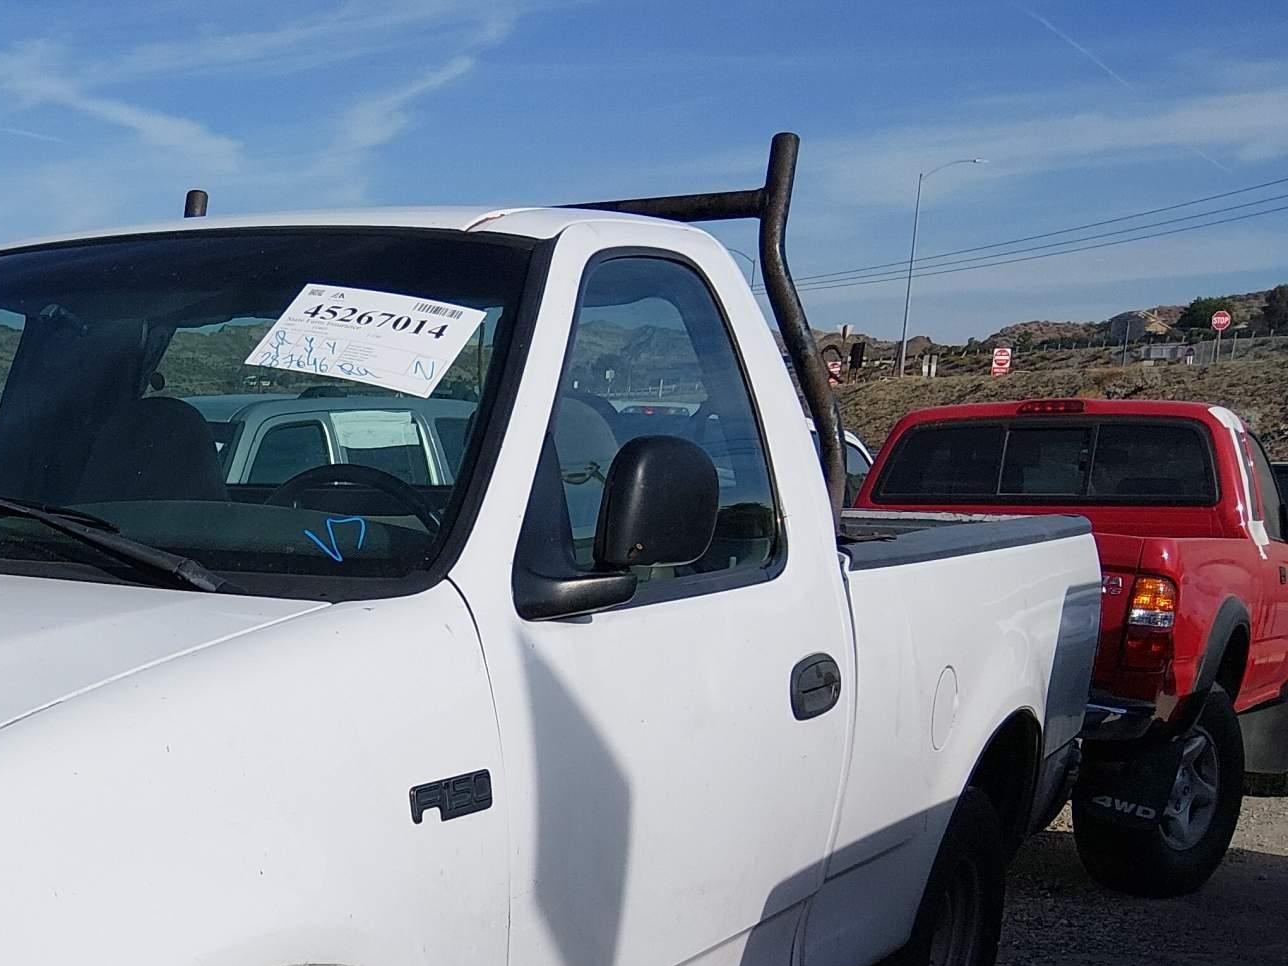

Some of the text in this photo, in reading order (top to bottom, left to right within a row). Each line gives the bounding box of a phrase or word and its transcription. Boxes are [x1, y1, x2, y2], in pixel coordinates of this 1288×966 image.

[303, 303, 449, 340] 45267014
[1213, 316, 1230, 325] STOP
[1092, 795, 1156, 819] 4WD
